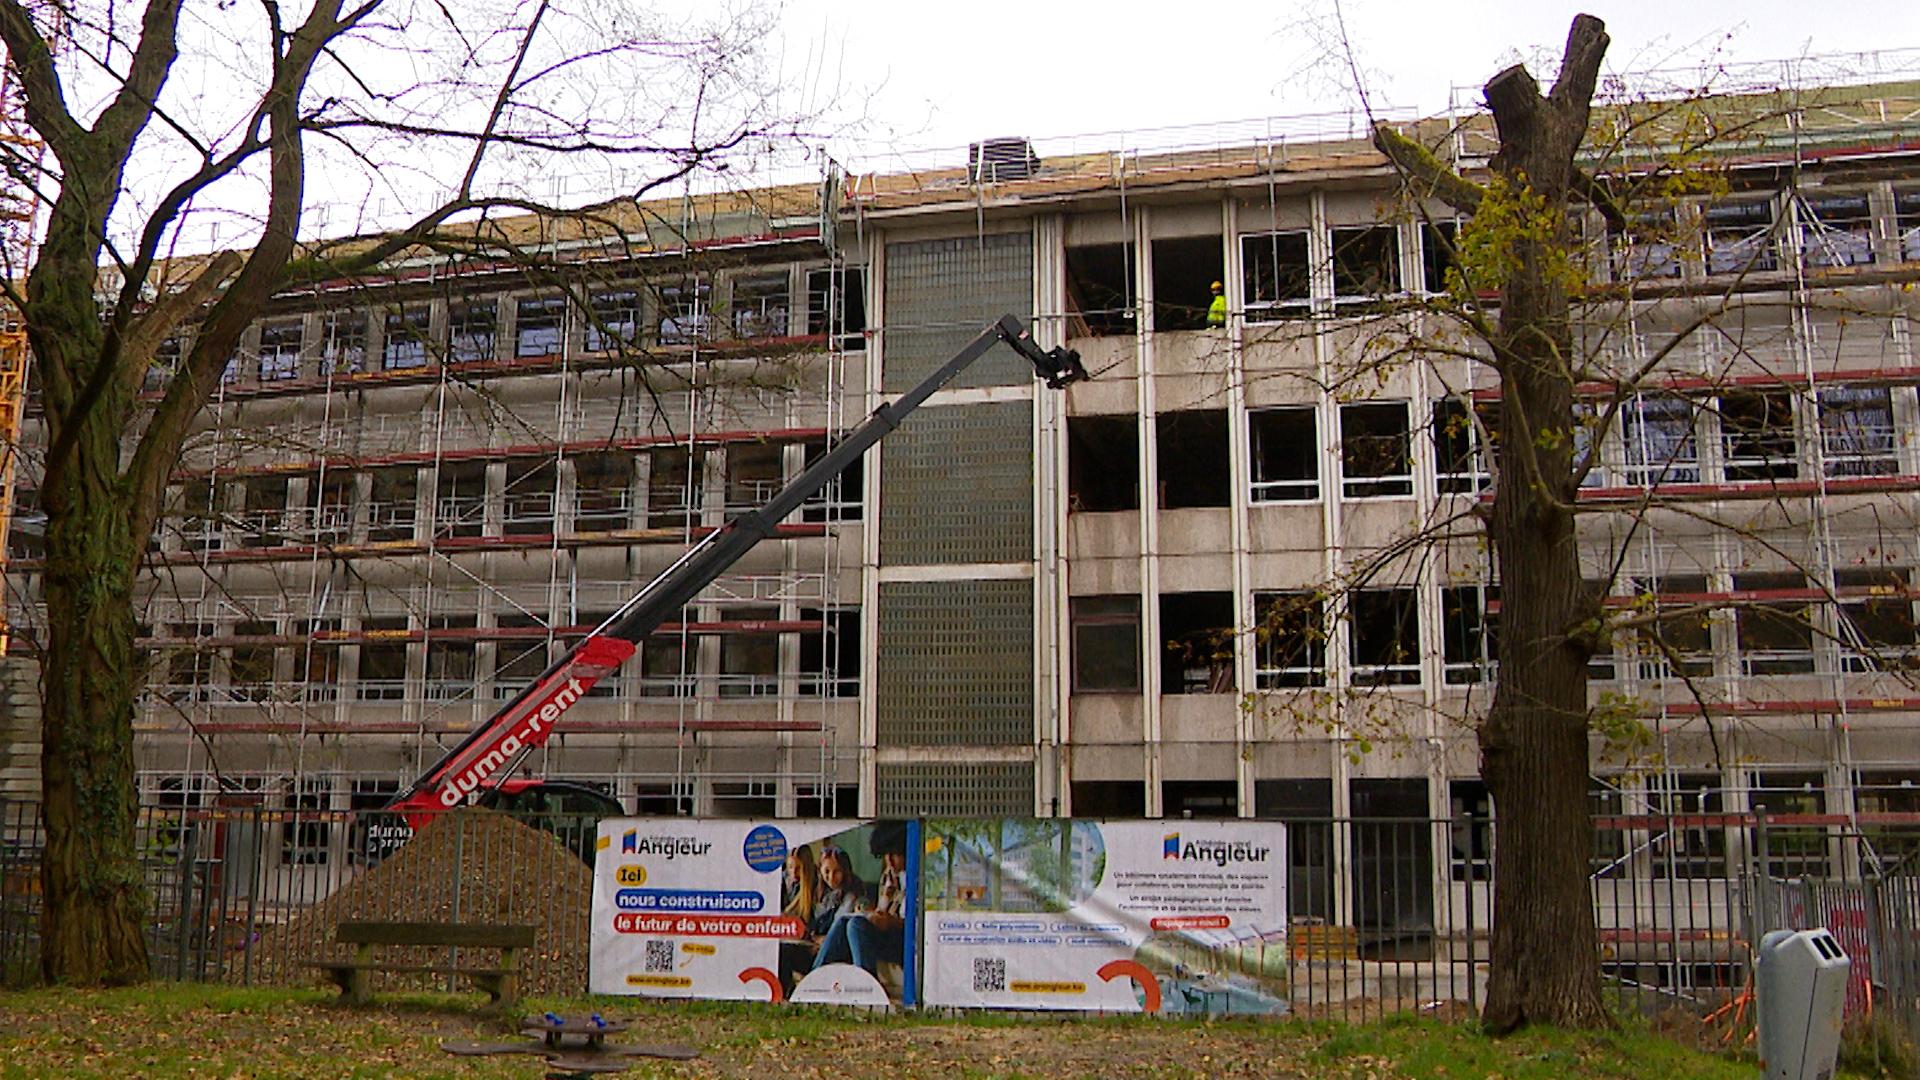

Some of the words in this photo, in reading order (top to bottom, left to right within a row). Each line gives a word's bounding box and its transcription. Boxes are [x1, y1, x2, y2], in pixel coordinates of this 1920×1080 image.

[440, 677, 585, 807] duma-rent
[638, 837, 712, 860] Angleur
[1182, 841, 1270, 867] Angleur
[621, 868, 641, 882] Ici
[618, 894, 656, 907] nous
[659, 893, 760, 910] construisons
[617, 916, 631, 929] le
[635, 916, 673, 931] futur
[676, 918, 696, 932] de
[700, 921, 742, 934] votre
[745, 920, 798, 936] enfant
